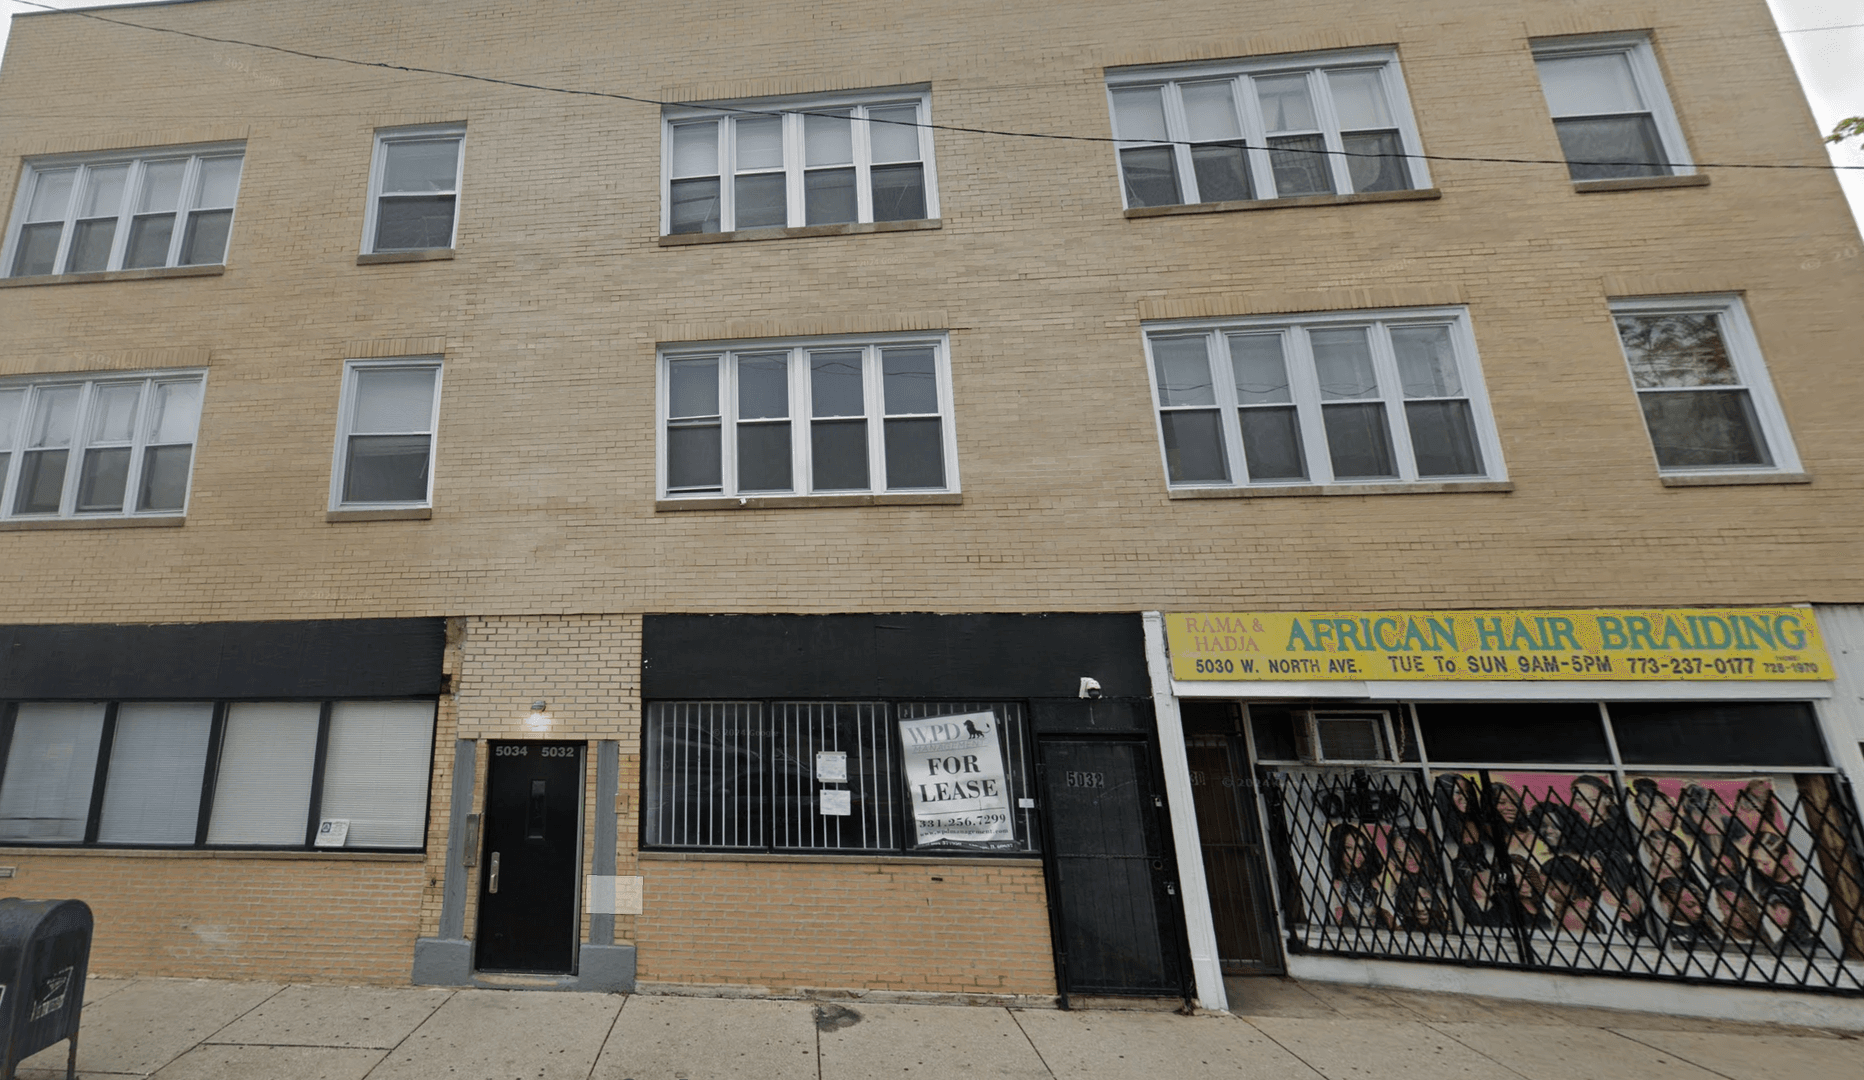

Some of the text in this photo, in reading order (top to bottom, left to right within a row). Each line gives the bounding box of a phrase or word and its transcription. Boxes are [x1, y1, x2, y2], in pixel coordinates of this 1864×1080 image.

[1184, 617, 1265, 633] RAMA &
[1286, 614, 1806, 652] AFRICAN HAIR BRAIDING
[1194, 635, 1260, 652] HADJA
[1196, 658, 1235, 674] 5030
[1240, 658, 1260, 674] W.
[1268, 658, 1321, 674] NORTH
[1328, 658, 1363, 674] AVE.
[1387, 655, 1426, 673] TUE
[1466, 655, 1509, 673] SUN
[1517, 655, 1613, 673] 9AM-5PM
[1626, 657, 1755, 675] 773-237-0177
[907, 723, 961, 744] WPD
[495, 745, 575, 758] 5034 5032
[912, 739, 986, 754] MANAGEMENT
[927, 754, 981, 776] FOR
[1066, 770, 1104, 788] 5032
[919, 779, 999, 803] LEASE
[919, 813, 1007, 828] 331.256.7299
